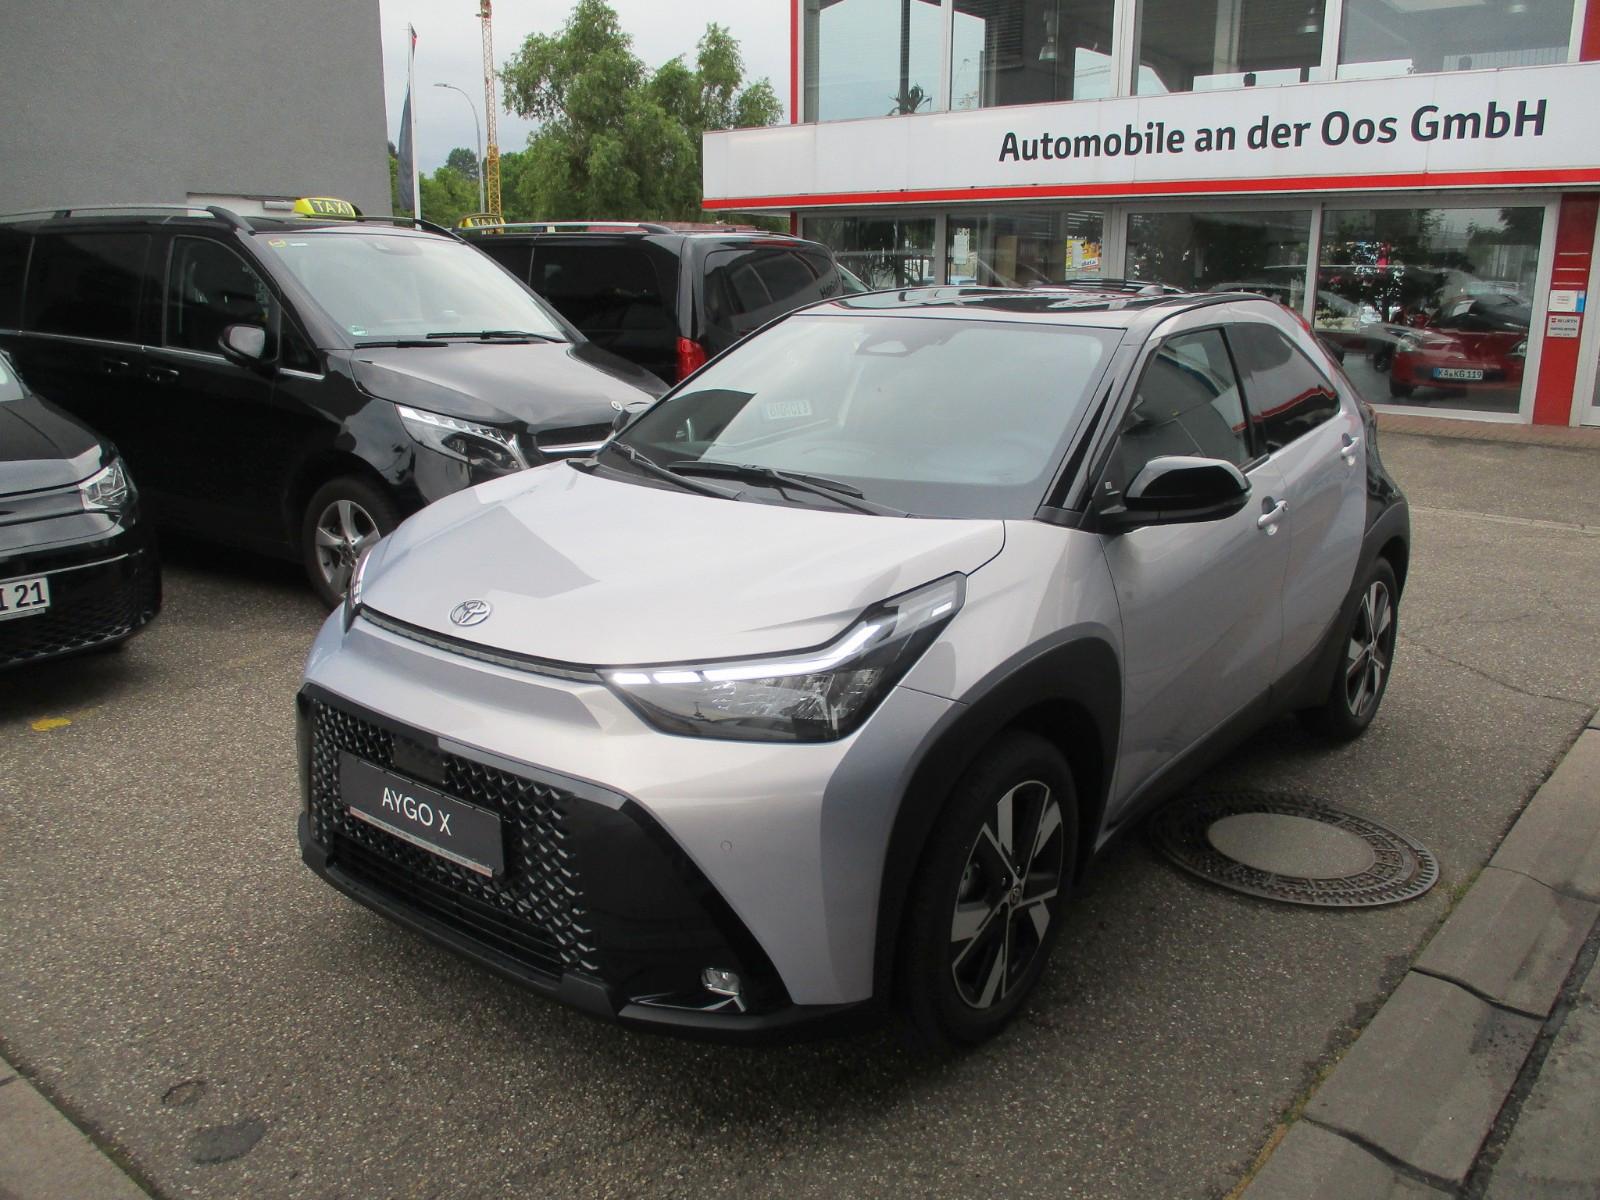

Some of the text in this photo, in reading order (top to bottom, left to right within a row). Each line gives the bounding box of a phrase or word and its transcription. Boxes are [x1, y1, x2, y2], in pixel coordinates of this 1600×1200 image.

[998, 98, 1547, 162] Automobile an der Oos GmbH
[313, 200, 350, 215] TAXI
[1454, 370, 1465, 378] KG
[14, 581, 46, 608] 21
[382, 787, 452, 836] AYGO X
